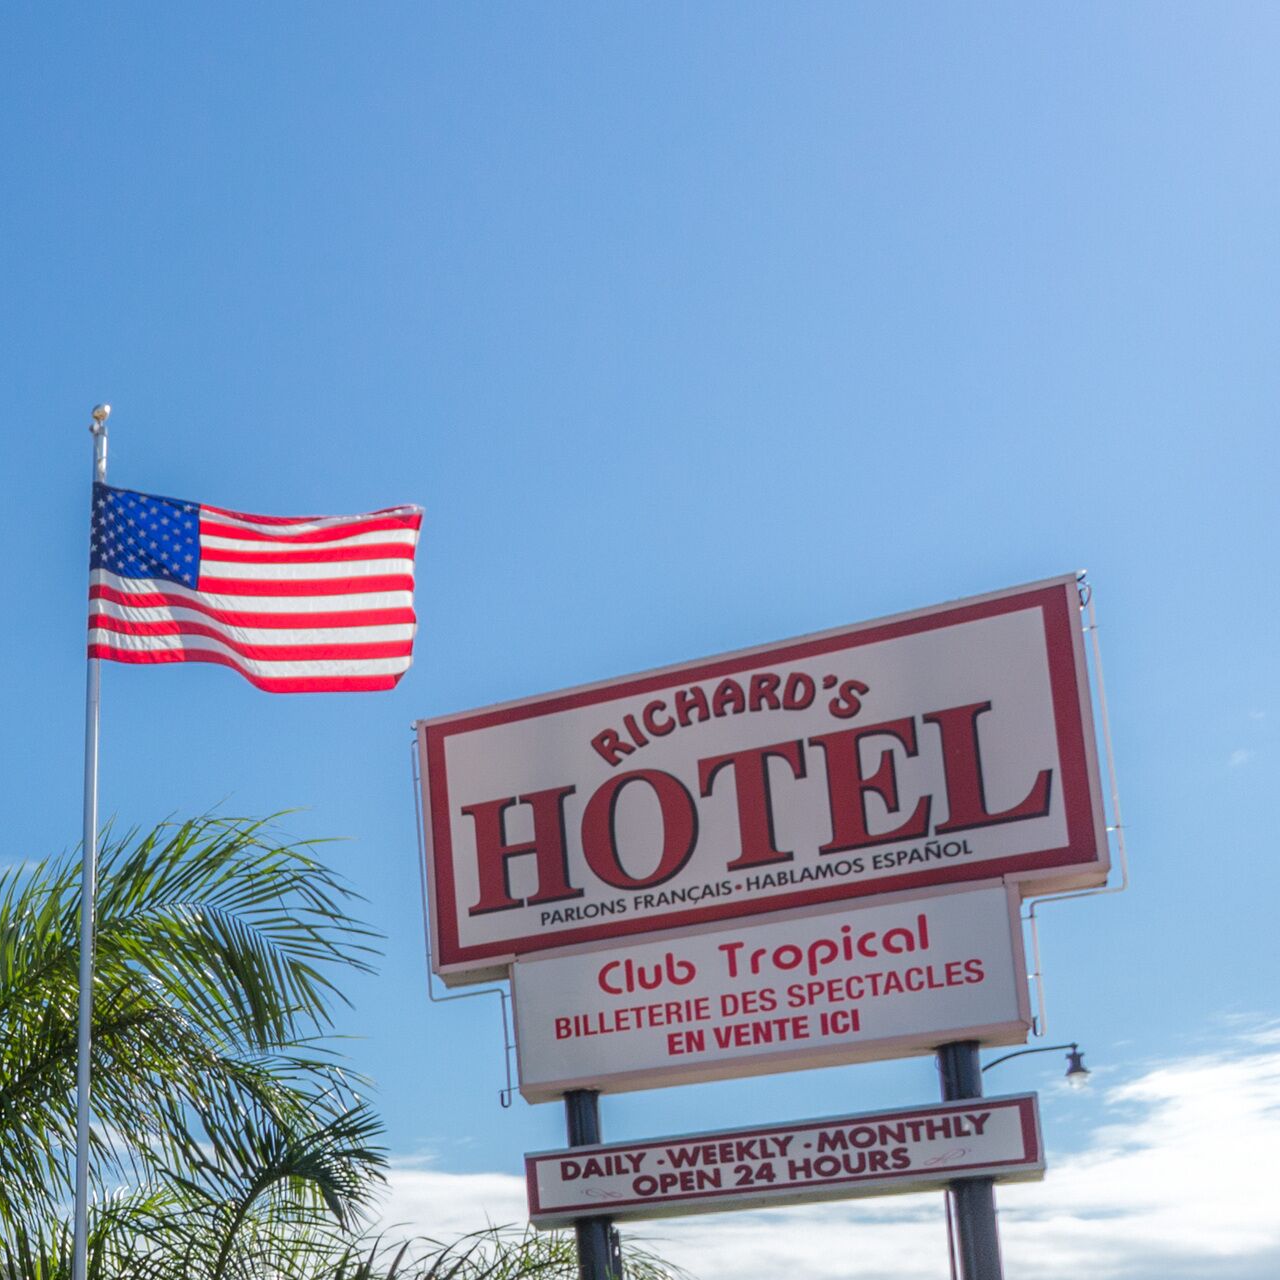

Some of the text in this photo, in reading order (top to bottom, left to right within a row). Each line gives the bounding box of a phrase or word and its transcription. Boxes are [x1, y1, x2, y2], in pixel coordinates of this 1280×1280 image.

[591, 672, 870, 768] RICHARD'S
[461, 700, 1054, 918] HOTEL
[540, 839, 973, 926] PARLONS FRANÇAIS HABLAMOS ESPAÑOL
[598, 913, 929, 995] Club Tropical
[555, 958, 985, 1041] BILLETERIE DES SPECTACLES
[667, 1008, 861, 1056] EN VENTE ICI
[560, 1152, 647, 1181] DAILY
[817, 1112, 991, 1153] MONTHLY
[632, 1147, 911, 1197] OPEN 24 HOURS
